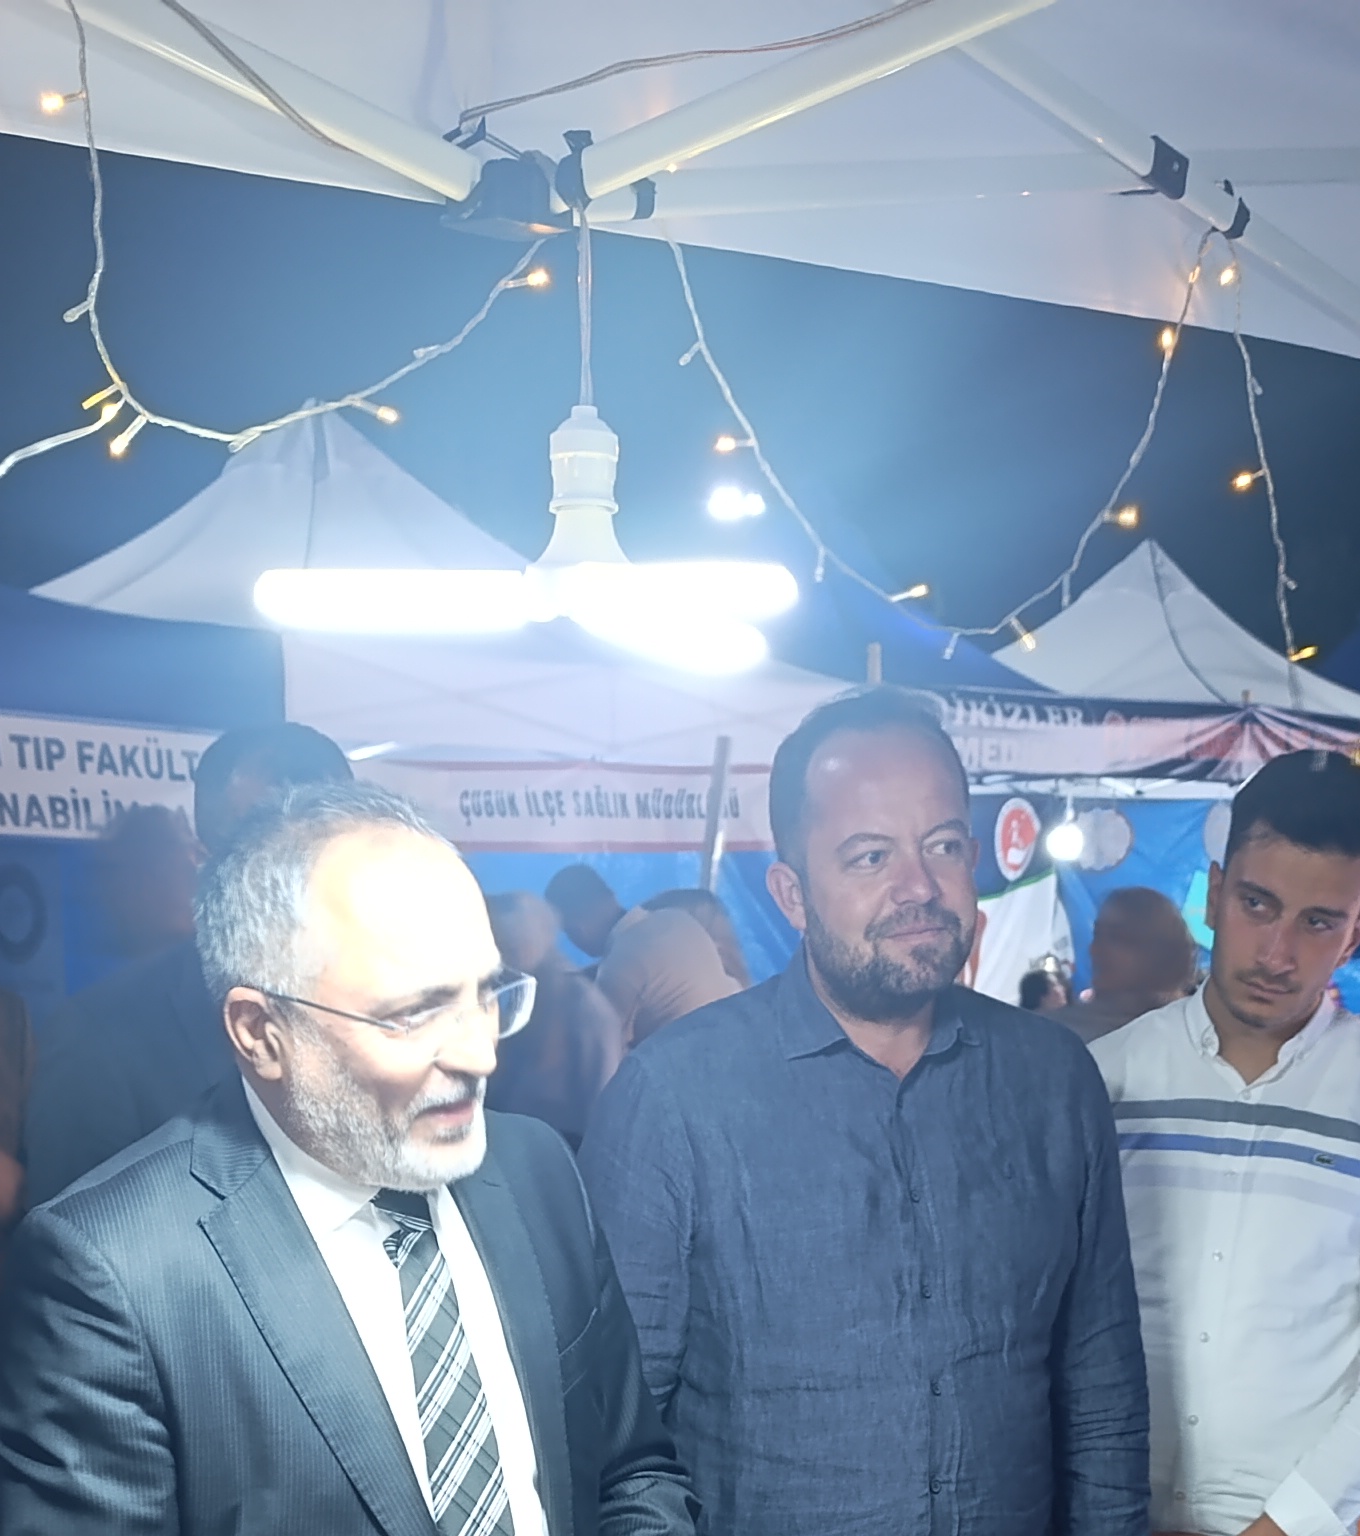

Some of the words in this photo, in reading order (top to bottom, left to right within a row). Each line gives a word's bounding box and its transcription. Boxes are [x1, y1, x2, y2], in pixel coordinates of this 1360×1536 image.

[9, 733, 67, 772] TIP
[459, 789, 520, 827] ÇUBUK
[524, 786, 566, 827] İLÇE
[573, 785, 631, 819] SAĞLIK
[635, 787, 740, 820] MÜDÜRLÜ
